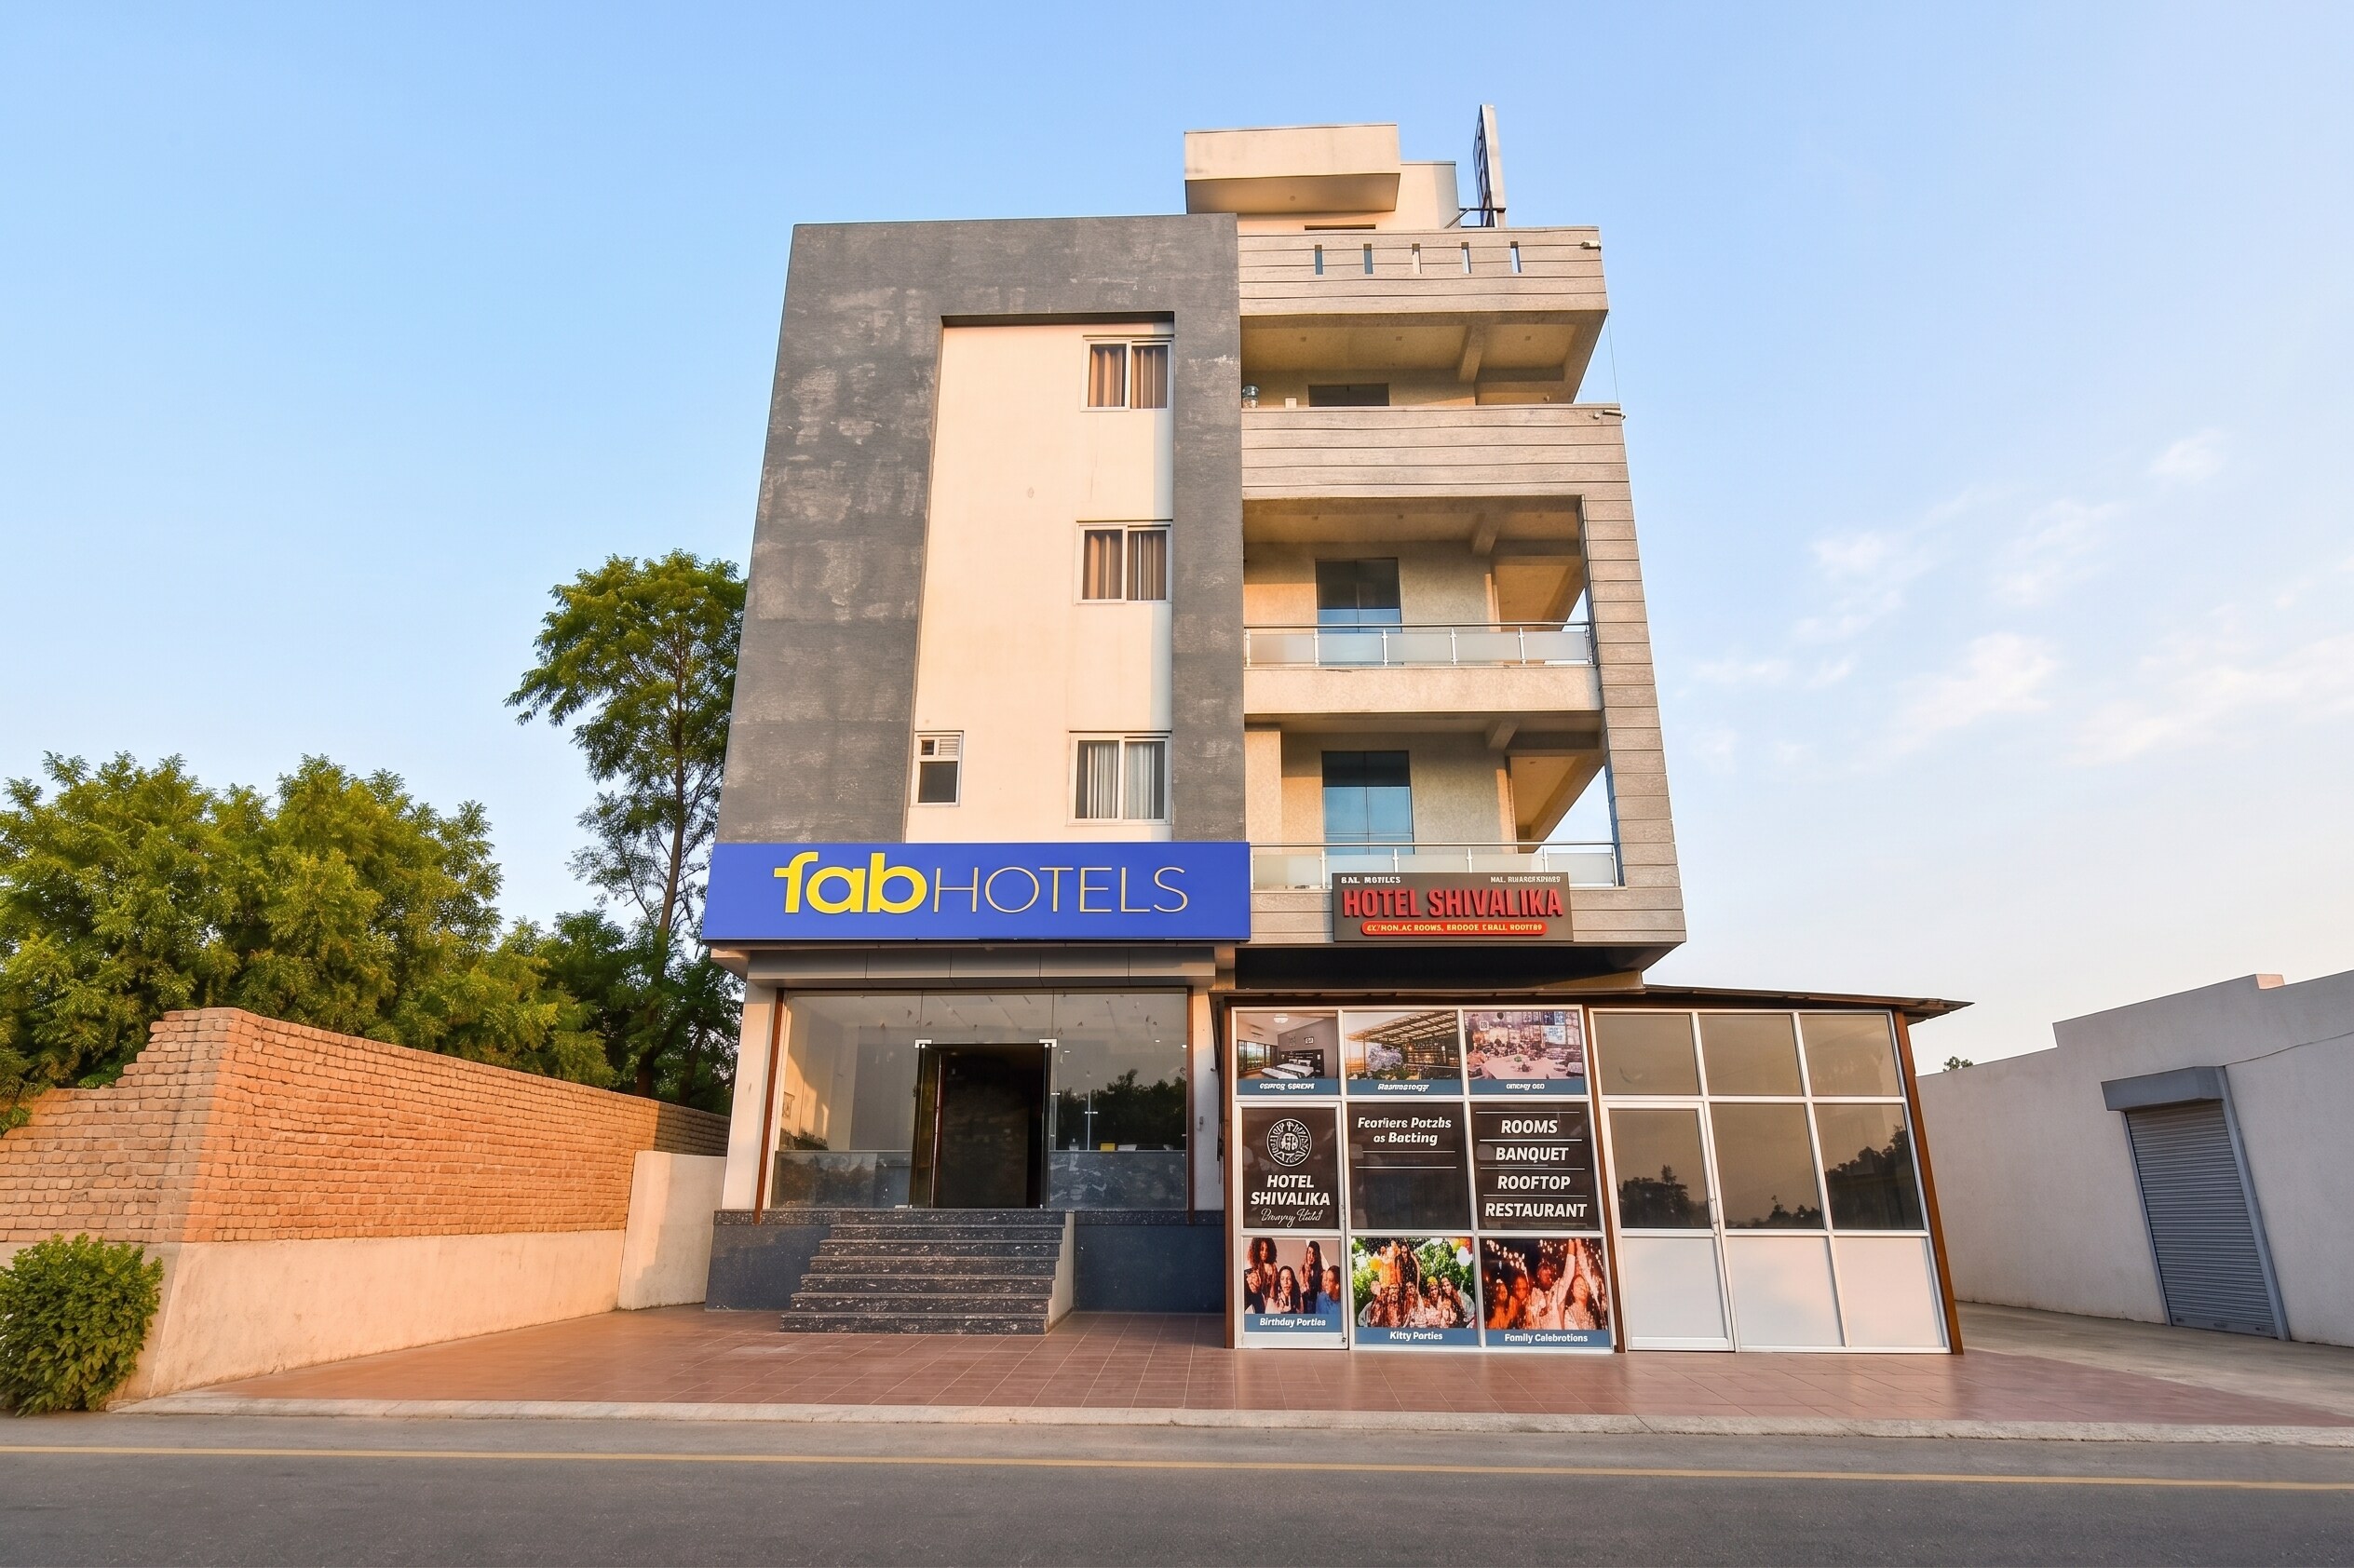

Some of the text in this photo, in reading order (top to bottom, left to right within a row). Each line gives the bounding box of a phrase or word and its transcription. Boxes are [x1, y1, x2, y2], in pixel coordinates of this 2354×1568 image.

[1343, 888, 1563, 917] HOTEL SHIVALIKA
[1501, 1119, 1558, 1134] ROOMS
[1495, 1146, 1569, 1163] BANQUET
[1266, 1174, 1315, 1188] HOTEL
[1497, 1175, 1571, 1190] ROOFTOP
[1250, 1191, 1331, 1206] SHIVALIKA
[1484, 1202, 1588, 1218] RESTAURANT
[1389, 1331, 1412, 1342] Kitty
